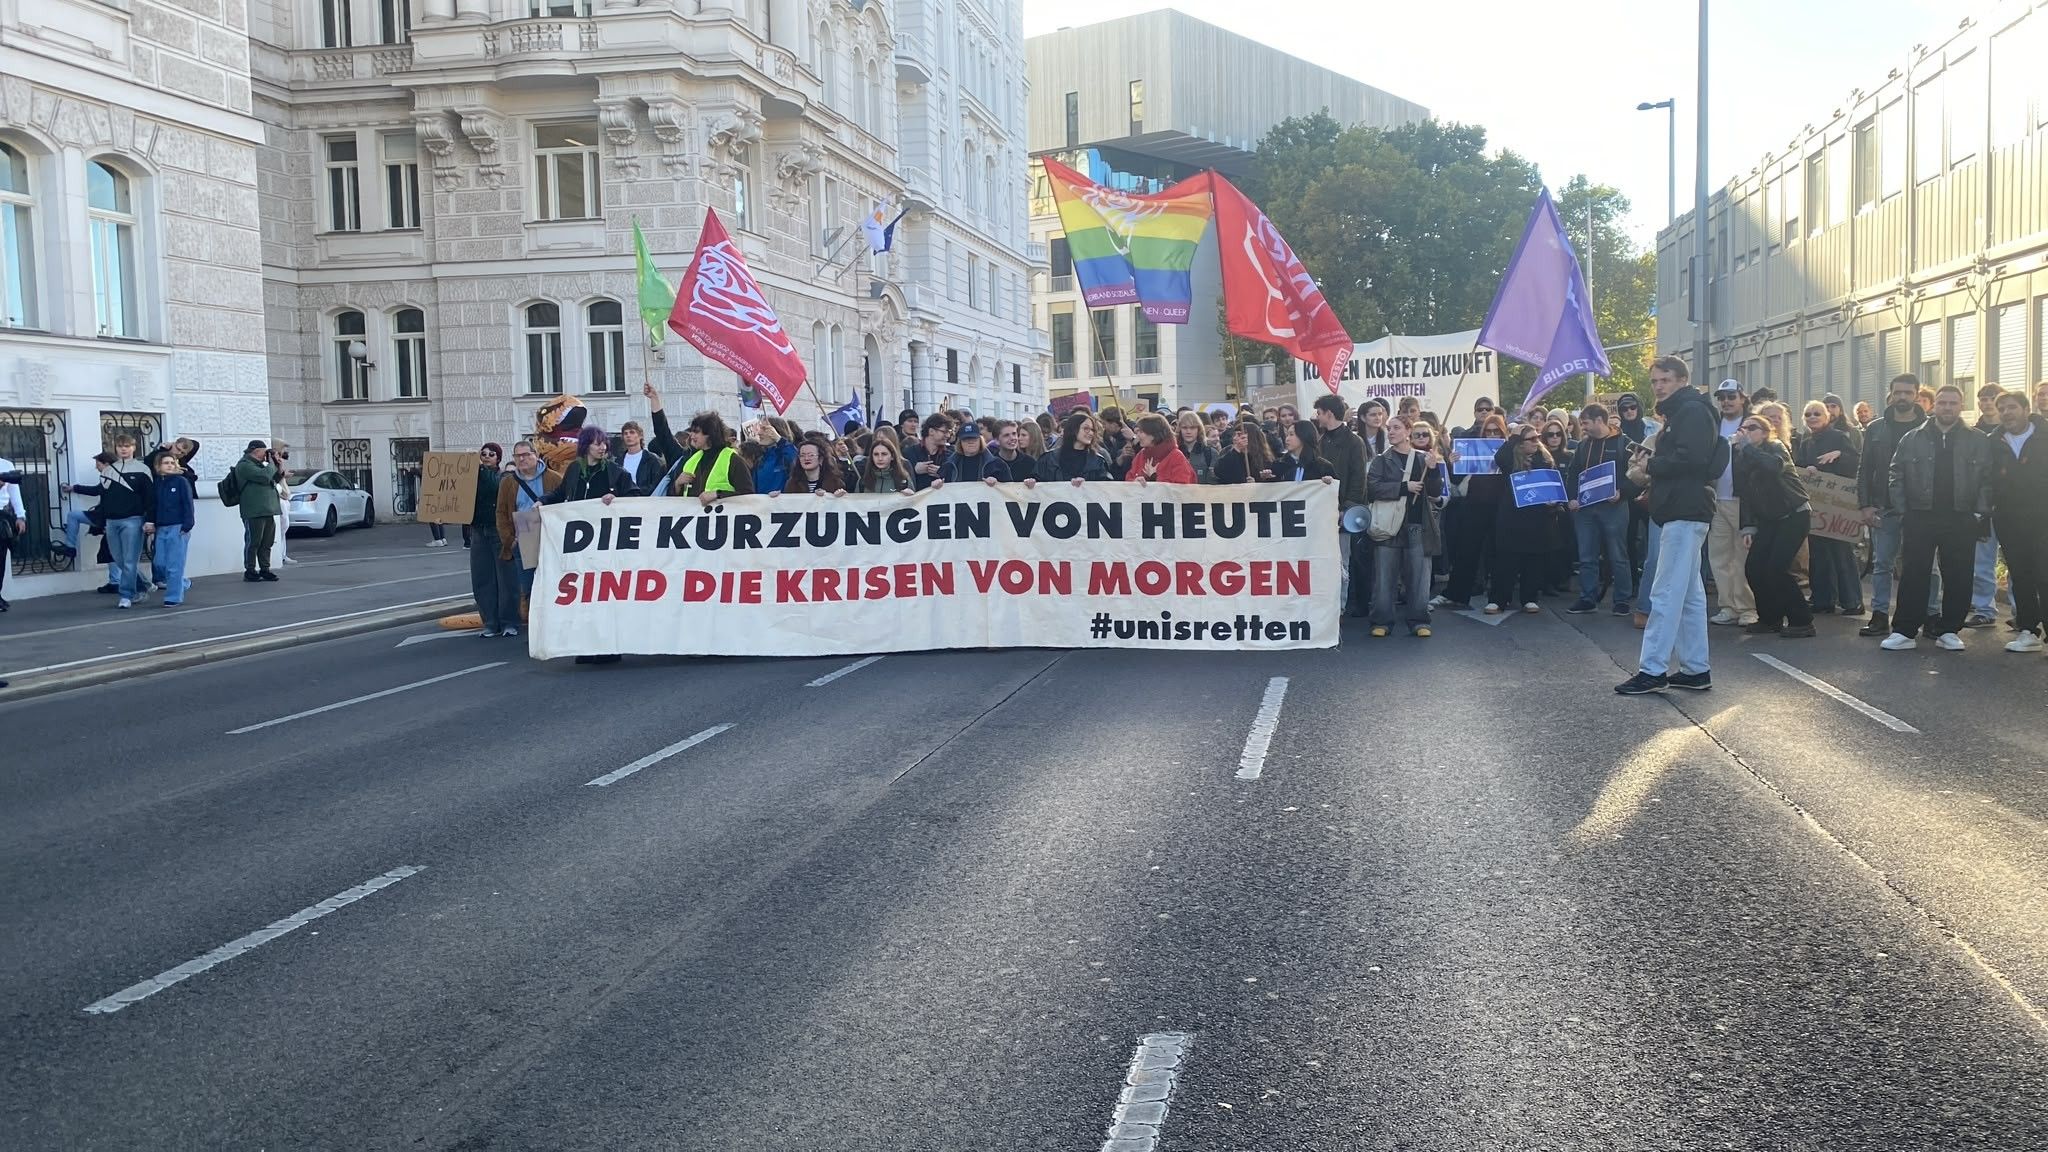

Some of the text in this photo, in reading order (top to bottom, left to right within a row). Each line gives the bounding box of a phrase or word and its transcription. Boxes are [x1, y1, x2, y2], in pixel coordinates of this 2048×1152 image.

[1163, 307, 1187, 317] QUEER
[1365, 357, 1419, 378] KOSTET
[1423, 351, 1492, 378] ZUKUNFT
[1543, 358, 1589, 384] BILDET
[1366, 383, 1426, 398] #UNISRETTEN
[563, 500, 1306, 554] DIE KÜRZUNGEN VON HEUTE
[554, 560, 1311, 606] SIND DIE KRISEN VON MORGEN
[1090, 611, 1311, 641] #unisretten
